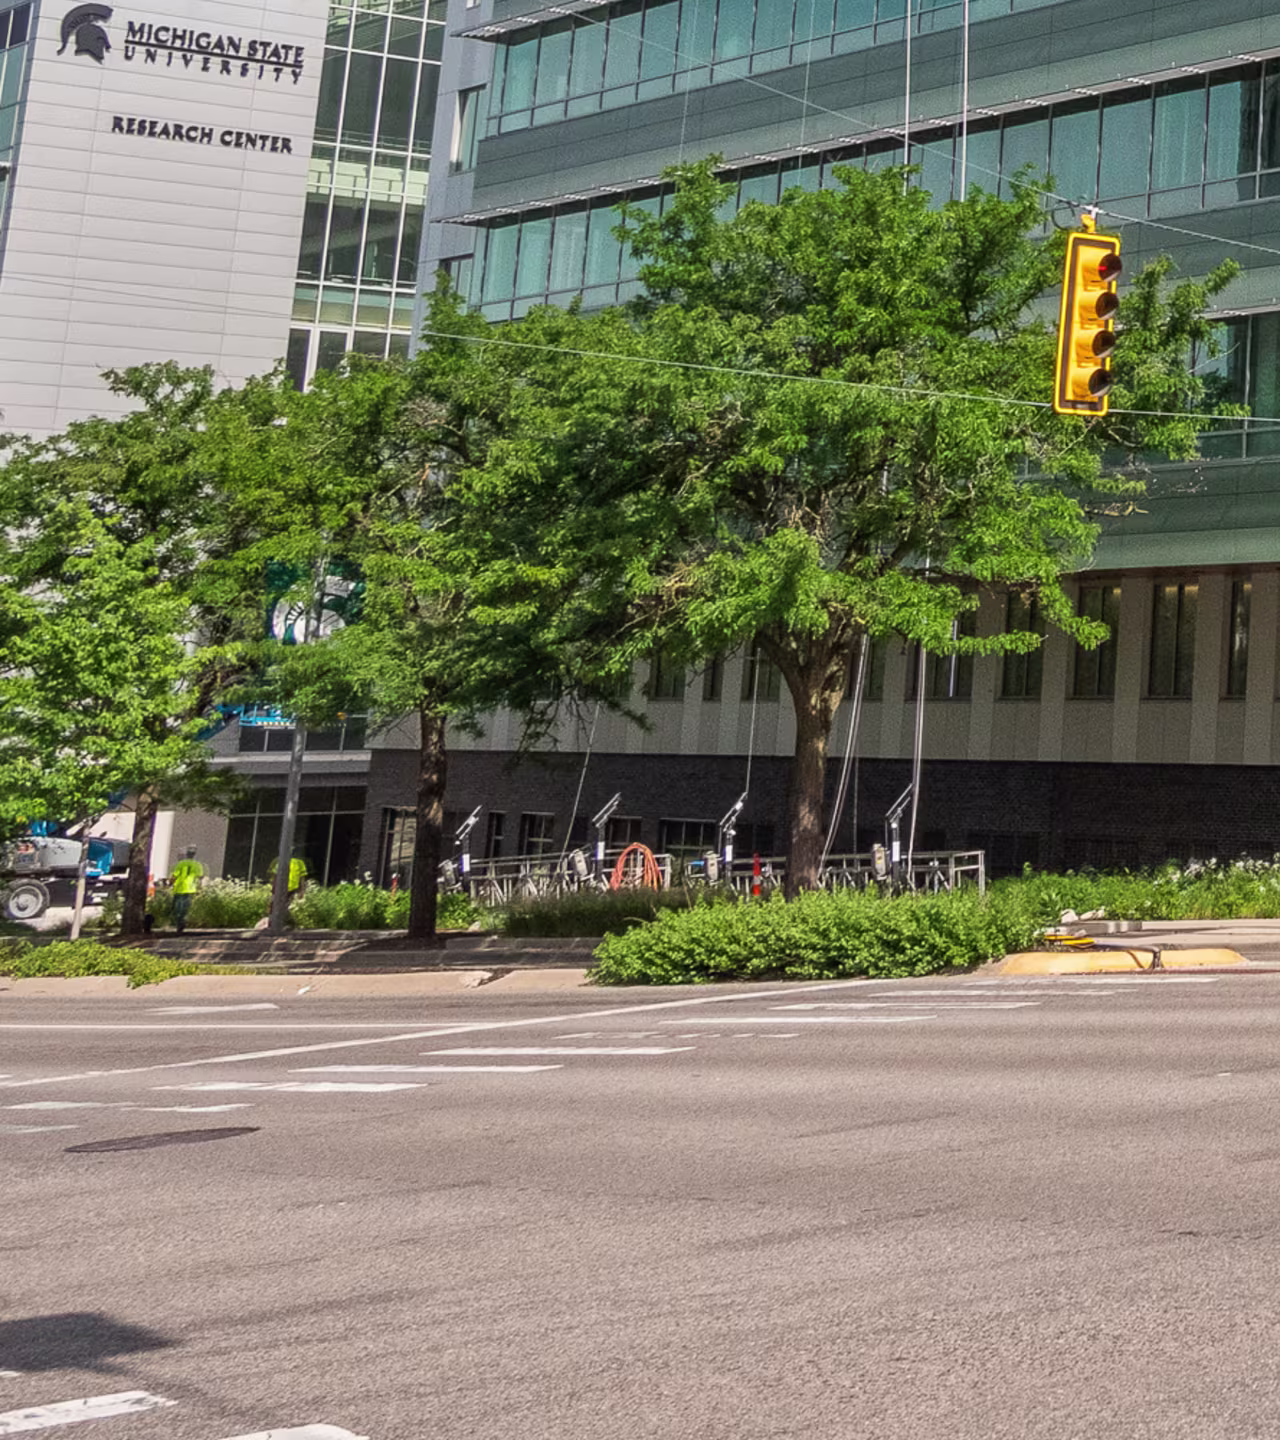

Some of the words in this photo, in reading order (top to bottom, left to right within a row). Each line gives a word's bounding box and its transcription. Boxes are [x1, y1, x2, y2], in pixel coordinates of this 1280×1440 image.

[126, 21, 242, 55] MICHIGAN
[247, 40, 305, 63] STATE
[124, 46, 302, 84] UNIVERSITY
[111, 116, 214, 144] RESEARCH
[219, 130, 293, 154] CENTER
